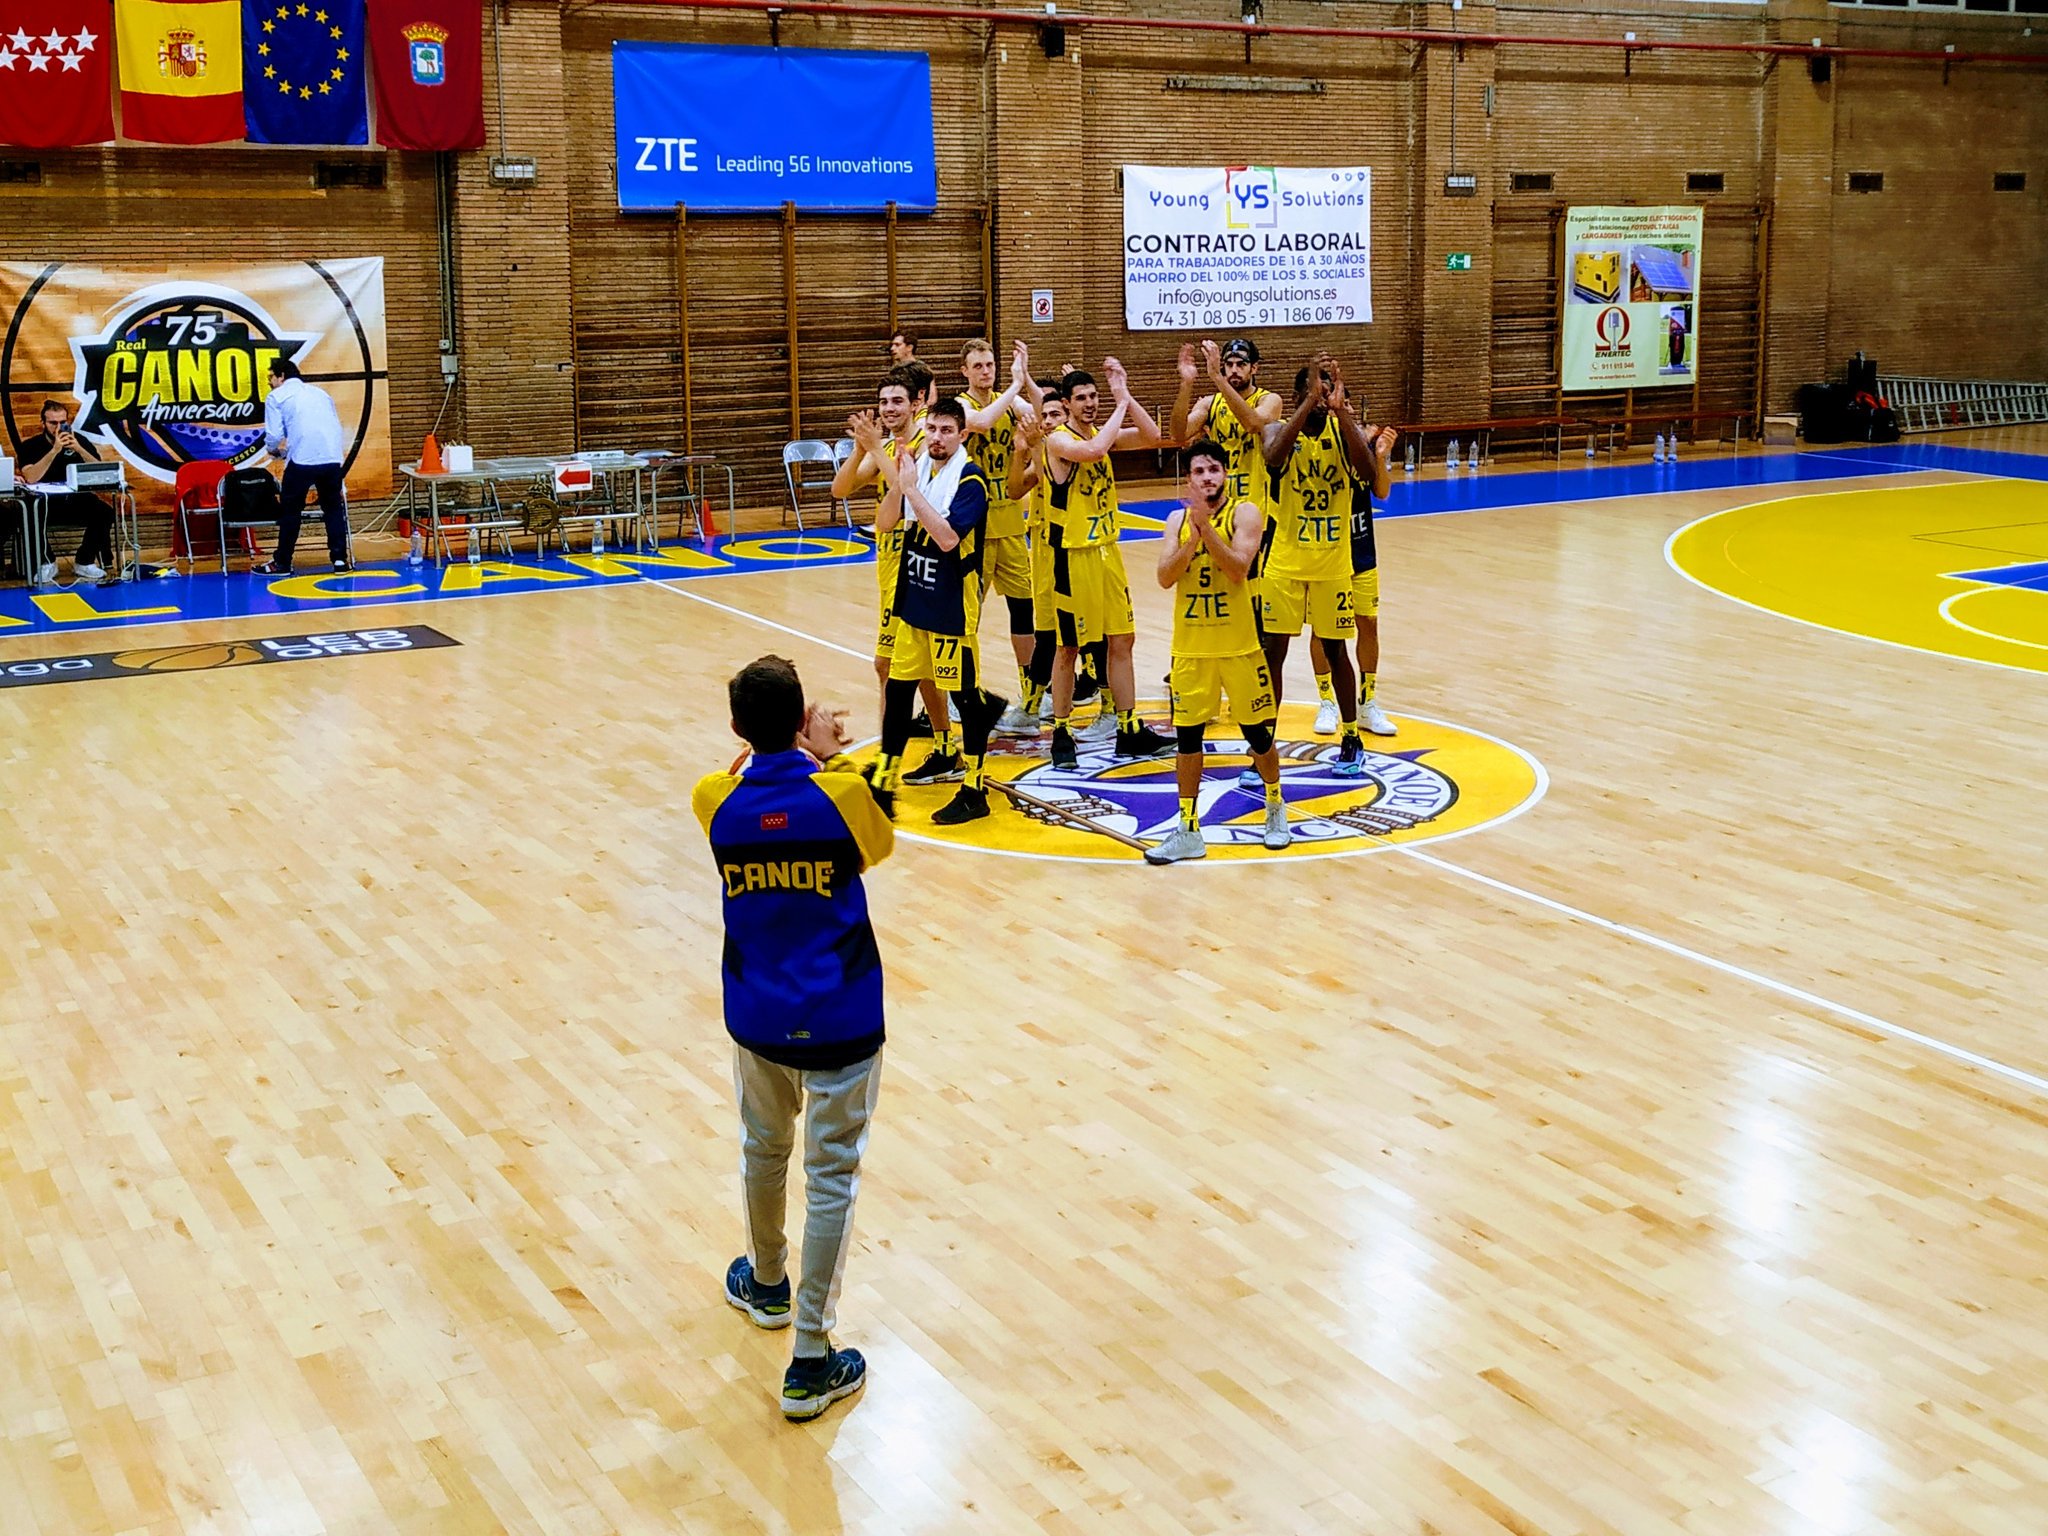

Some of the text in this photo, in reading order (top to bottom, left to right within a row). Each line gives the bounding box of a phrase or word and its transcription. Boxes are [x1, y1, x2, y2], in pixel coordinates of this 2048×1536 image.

[635, 137, 913, 177] ZTE Leading 5G Innovations
[1150, 184, 1364, 211] Young YS Solutions
[1127, 232, 1366, 253] CONTRATO LABORAL
[1127, 251, 1366, 268] PARA TRABAJADORES DE 16 A 30 AÑOS
[1128, 268, 1365, 283] AHORRO DEL 100% DE LOS S. SOCIALES
[1158, 286, 1337, 307] info@youngsolutions.es
[1143, 311, 1174, 326] 674
[1179, 311, 1196, 326] 31
[1203, 310, 1222, 325] 08
[1227, 309, 1247, 324] 05
[1259, 308, 1276, 323] 91
[1284, 307, 1311, 322] 186
[1315, 306, 1332, 321] 06
[1336, 305, 1355, 320] 79
[165, 315, 217, 346] 75
[116, 338, 147, 351] Real
[1595, 350, 1632, 358] ENERTEC
[140, 393, 254, 431] Aniversario
[988, 453, 1004, 473] 14
[1227, 473, 1250, 497] TE
[1302, 489, 1329, 511] 23
[1297, 515, 1341, 542] ZTE
[1351, 511, 1368, 534] TE
[907, 550, 939, 583] ZTE
[1199, 566, 1211, 588] 5
[1184, 592, 1230, 618] ZTE
[881, 608, 891, 628] 9
[261, 630, 409, 650] LEB
[277, 639, 414, 658] ORO
[934, 638, 959, 660] 77
[1256, 665, 1268, 688] 5
[723, 861, 833, 898] CANOE
